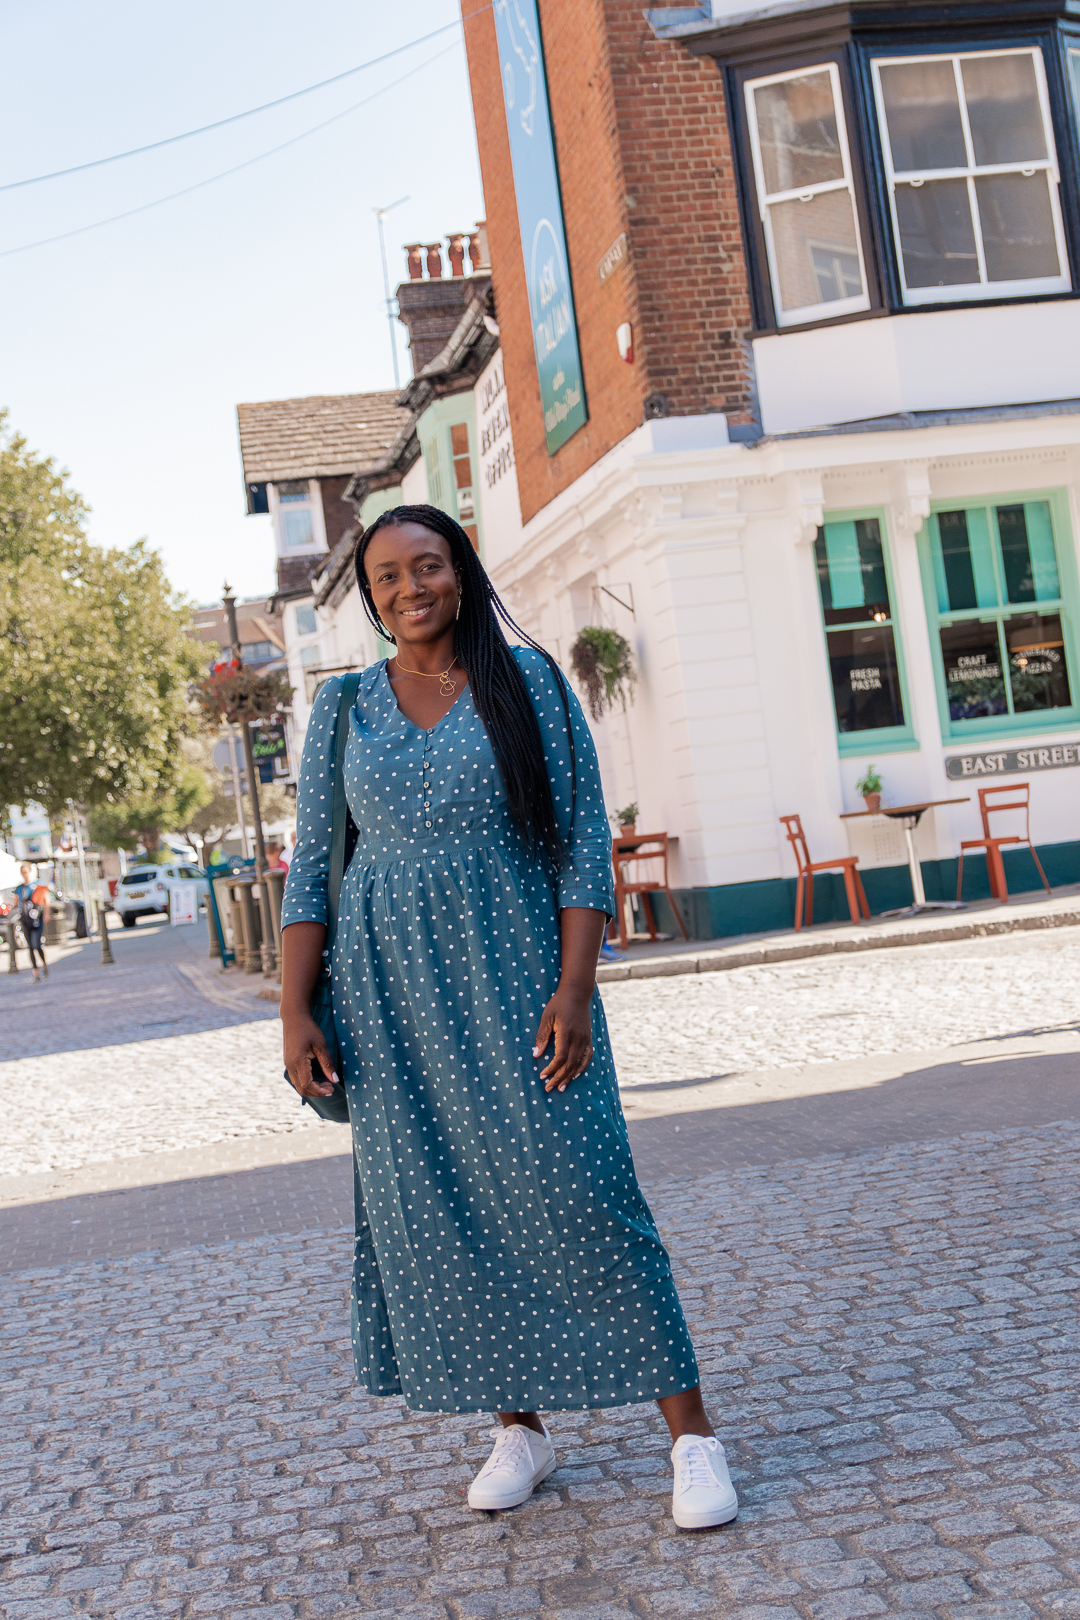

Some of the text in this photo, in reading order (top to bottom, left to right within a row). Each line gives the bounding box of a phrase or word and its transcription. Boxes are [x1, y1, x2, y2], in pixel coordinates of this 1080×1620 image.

[958, 654, 987, 668] CRAFT
[1020, 661, 1053, 675] PIZZAS
[850, 668, 880, 681] FRESH
[949, 667, 999, 683] LEMONADE
[851, 678, 882, 691] PASTA
[961, 754, 1007, 775] EAST
